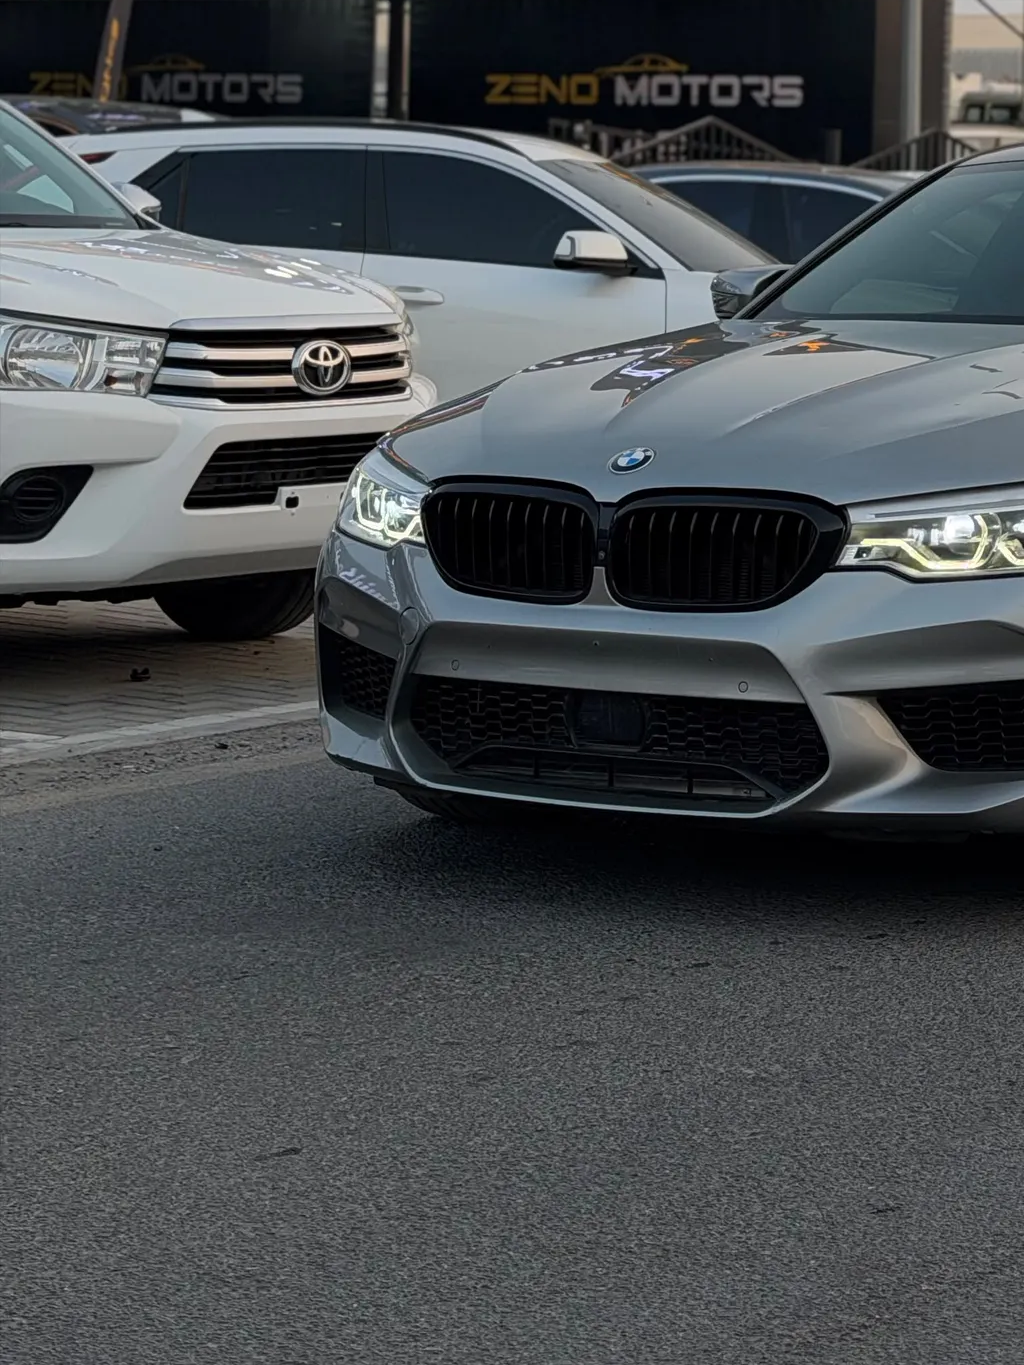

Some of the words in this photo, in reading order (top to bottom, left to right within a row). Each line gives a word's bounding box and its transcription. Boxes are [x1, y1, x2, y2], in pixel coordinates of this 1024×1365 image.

[140, 72, 303, 104] MOTORS
[484, 73, 600, 105] ZENO
[613, 74, 804, 107] MOTORS
